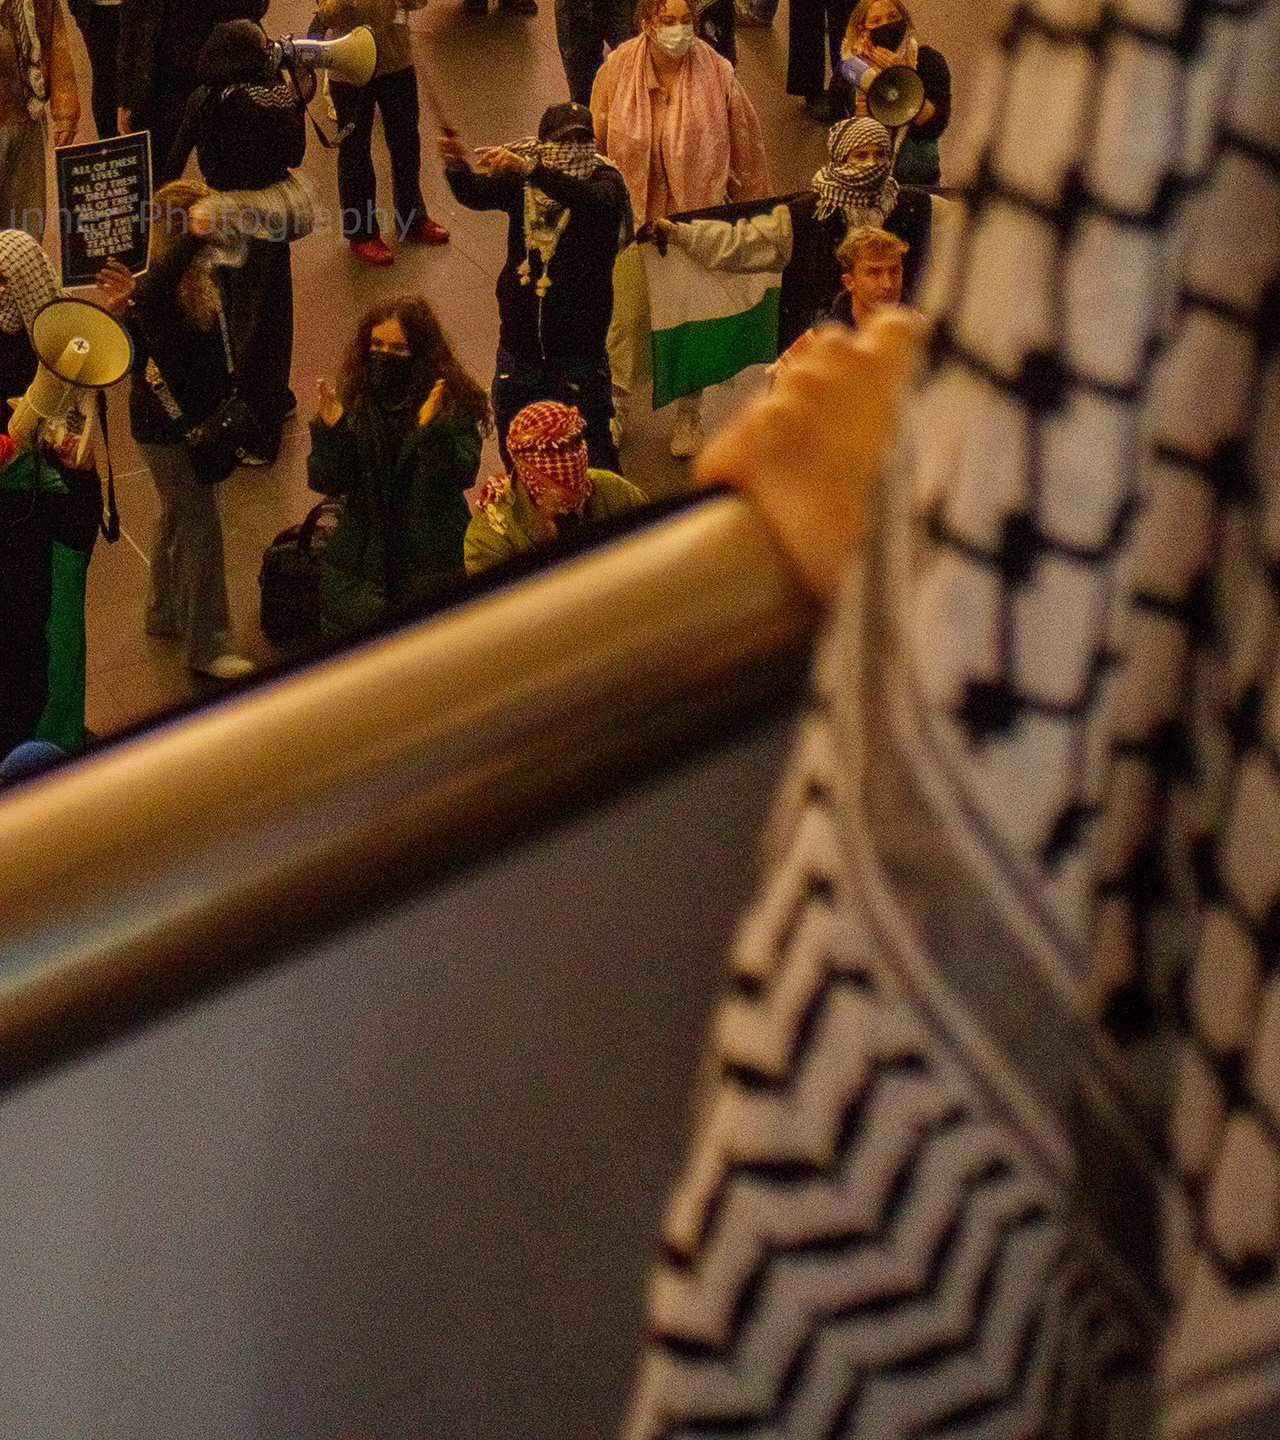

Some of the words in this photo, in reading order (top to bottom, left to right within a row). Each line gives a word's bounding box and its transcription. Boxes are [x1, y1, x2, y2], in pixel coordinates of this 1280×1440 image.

[72, 165, 91, 176] ALL
[93, 162, 107, 172] OF
[109, 156, 137, 169] THESE
[91, 170, 120, 182] LIVES
[72, 185, 91, 196] ALL
[94, 181, 108, 192] OF
[110, 175, 138, 188] THESE
[85, 187, 129, 201] DREAMS
[95, 200, 109, 211] OF
[98, 220, 111, 231] OF
[122, 234, 133, 243] IN
[86, 247, 107, 258] THE
